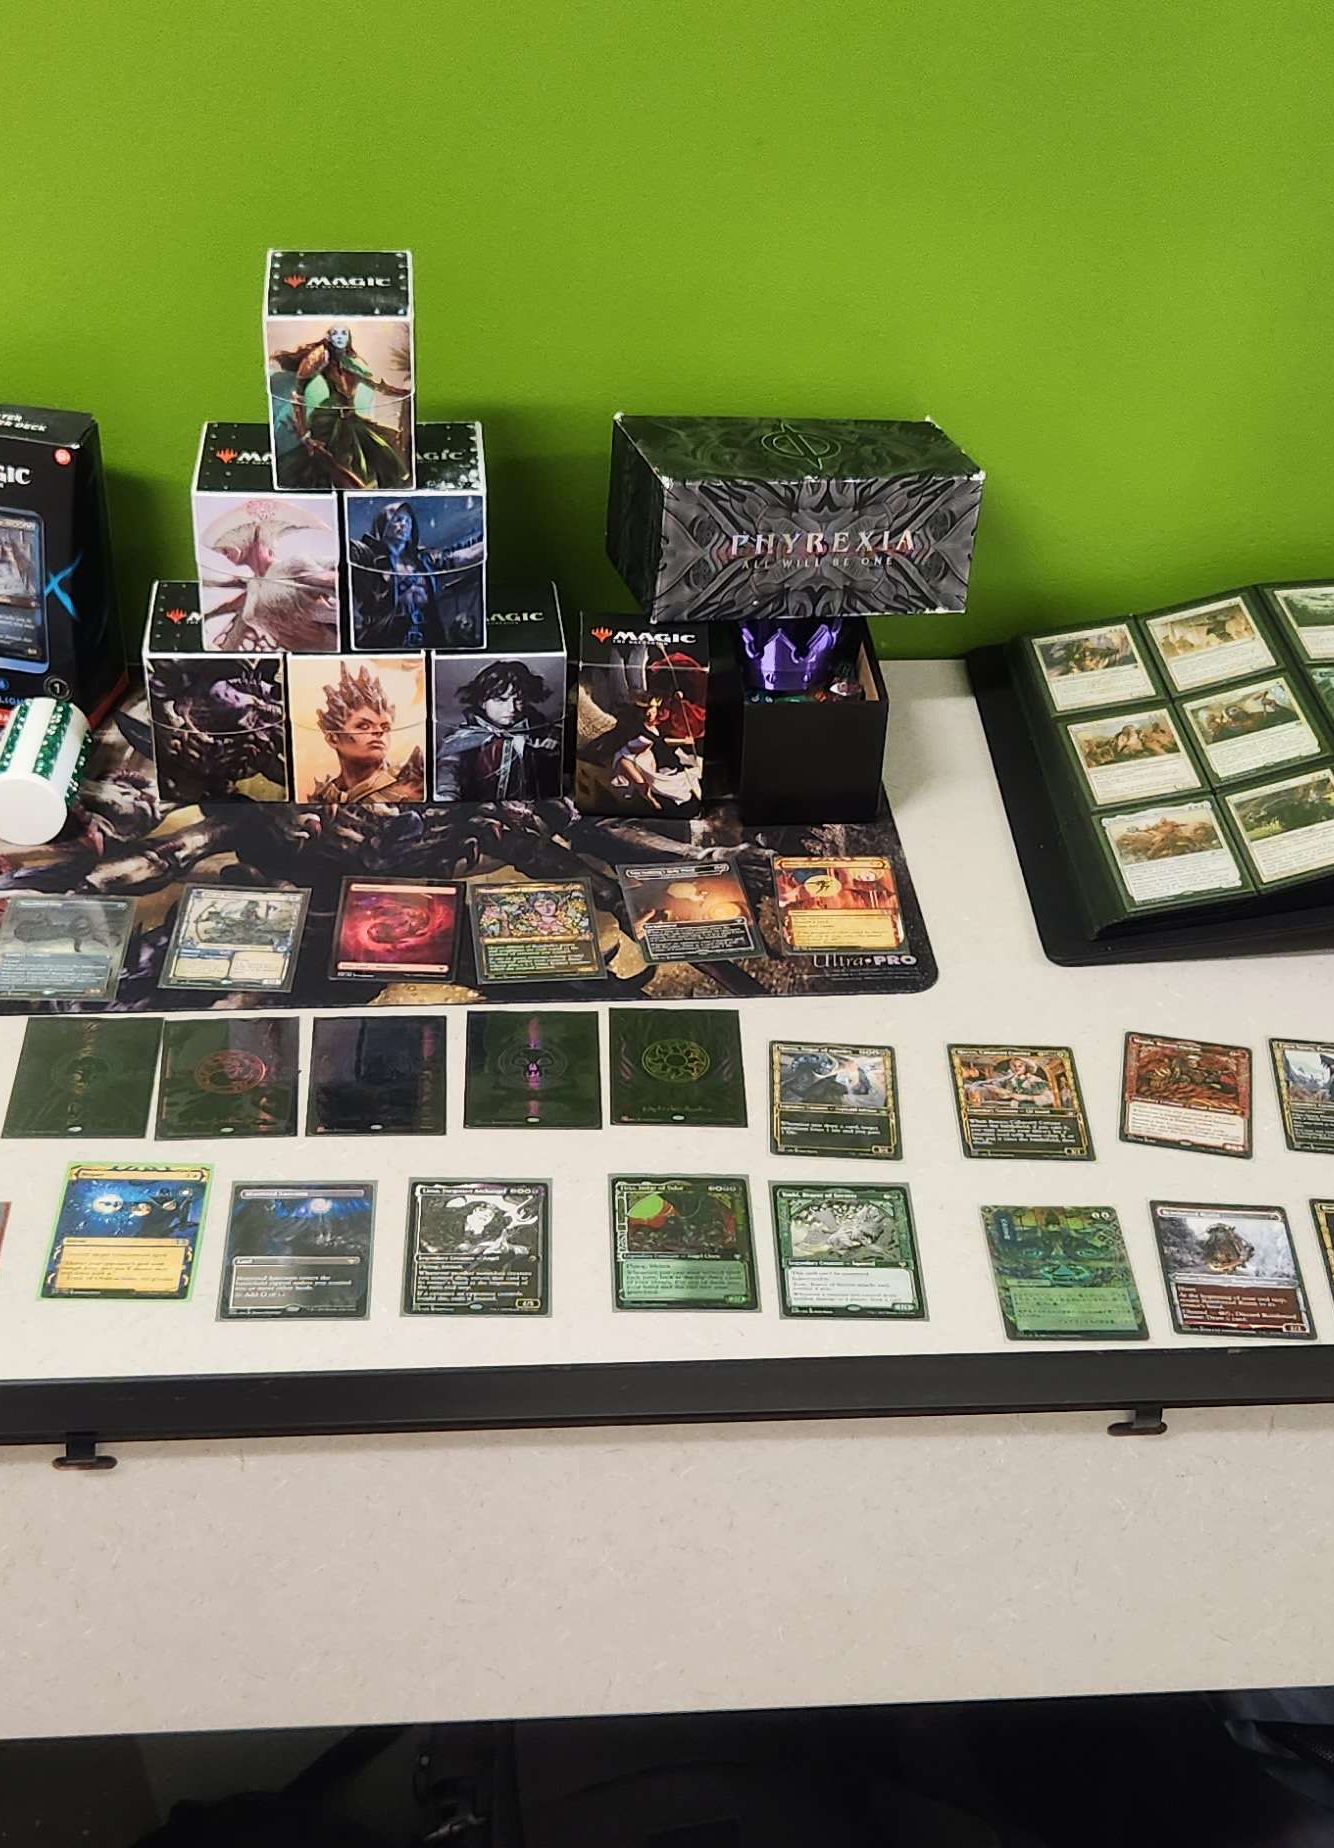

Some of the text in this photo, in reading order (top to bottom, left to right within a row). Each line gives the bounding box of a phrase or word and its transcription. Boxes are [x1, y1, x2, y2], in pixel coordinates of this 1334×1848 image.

[307, 277, 392, 287] MAGIC
[14, 421, 48, 432] DECK
[731, 530, 916, 556] PHYREXIA
[741, 556, 893, 569] ALL WILL BE ONE
[487, 612, 545, 622] AGIC
[613, 631, 697, 644] MAGIC
[53, 683, 61, 694] 1
